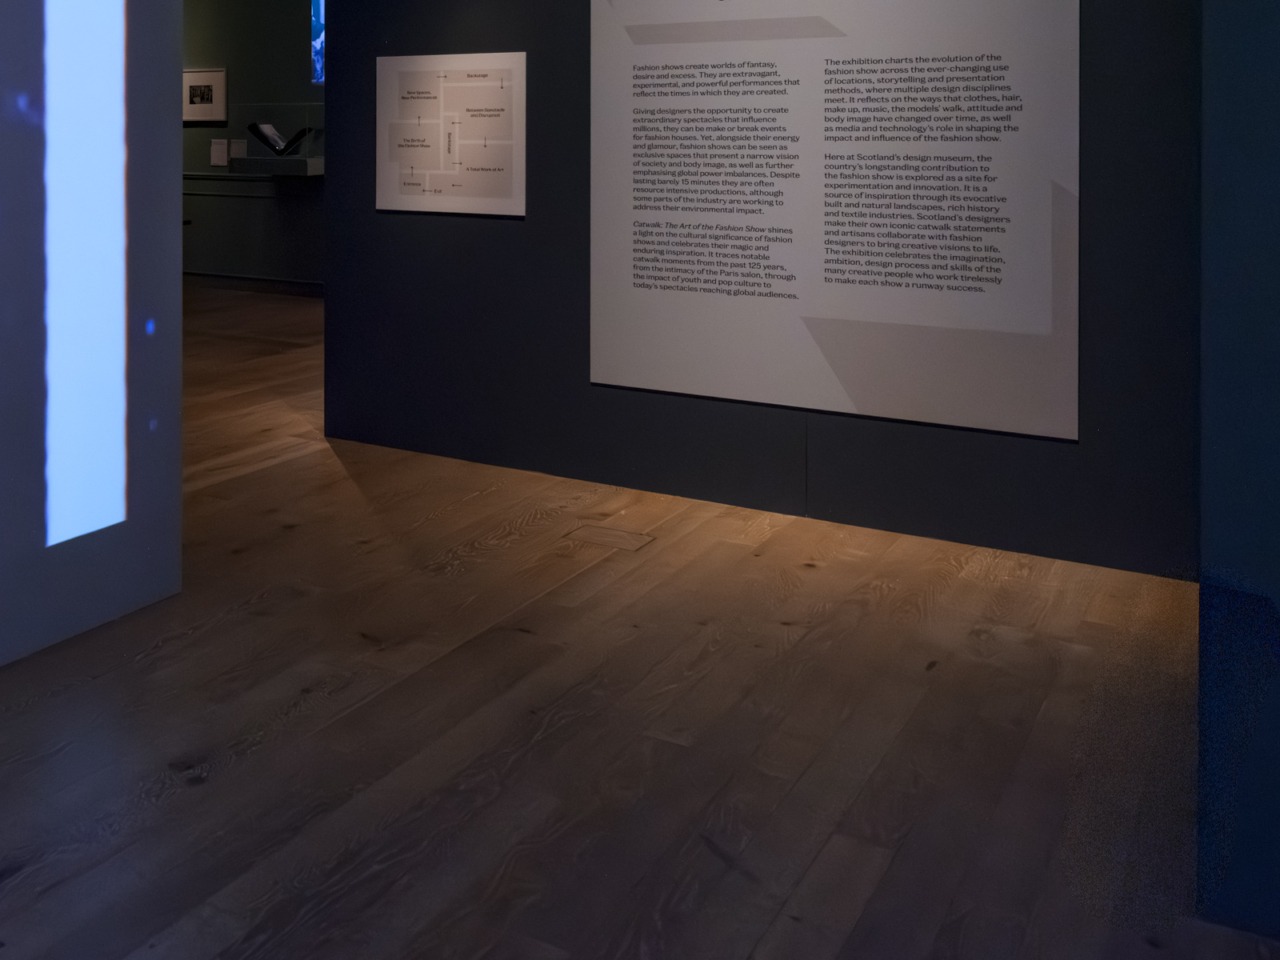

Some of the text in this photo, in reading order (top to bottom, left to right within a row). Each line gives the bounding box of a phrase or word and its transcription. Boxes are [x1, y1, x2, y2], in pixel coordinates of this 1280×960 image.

[824, 58, 841, 66] The
[931, 55, 973, 63] evolution
[974, 53, 986, 62] of
[737, 61, 746, 69] of
[856, 67, 879, 75] show
[926, 65, 992, 73] ever-changing
[699, 71, 717, 79] They
[695, 80, 729, 88] powerful
[824, 77, 834, 85] of
[877, 76, 926, 85] storytelling
[927, 75, 944, 83] and
[946, 75, 1005, 83] presentation
[632, 90, 656, 98] reflect
[723, 89, 741, 97] they
[893, 85, 929, 94] multiple
[931, 85, 961, 93] design
[962, 84, 1012, 93] disciplines
[857, 95, 890, 103] reflects
[632, 108, 656, 116] Giving
[656, 108, 692, 116] designers
[706, 107, 752, 115] opportunity
[683, 116, 723, 124] spectacles
[824, 115, 845, 124] body
[894, 115, 932, 124] changed
[992, 114, 1011, 122] well
[716, 134, 752, 142] alongside
[772, 135, 800, 143] energy
[854, 134, 870, 142] and
[871, 134, 911, 142] influence
[912, 134, 923, 142] of
[940, 134, 973, 142] fashion
[824, 153, 845, 161] Here
[902, 154, 932, 163] design
[847, 220, 868, 228] their
[889, 222, 916, 230] iconic
[917, 223, 951, 231] catwalk
[953, 225, 1006, 233] statements
[841, 230, 875, 238] artisans
[876, 231, 926, 240] collaborate
[949, 234, 983, 242] fashion
[748, 262, 762, 270] 125
[864, 260, 893, 269] design
[931, 263, 948, 271] and
[950, 264, 973, 272] skills
[834, 277, 857, 285] make
[880, 279, 903, 288] show
[911, 283, 944, 291] runway
